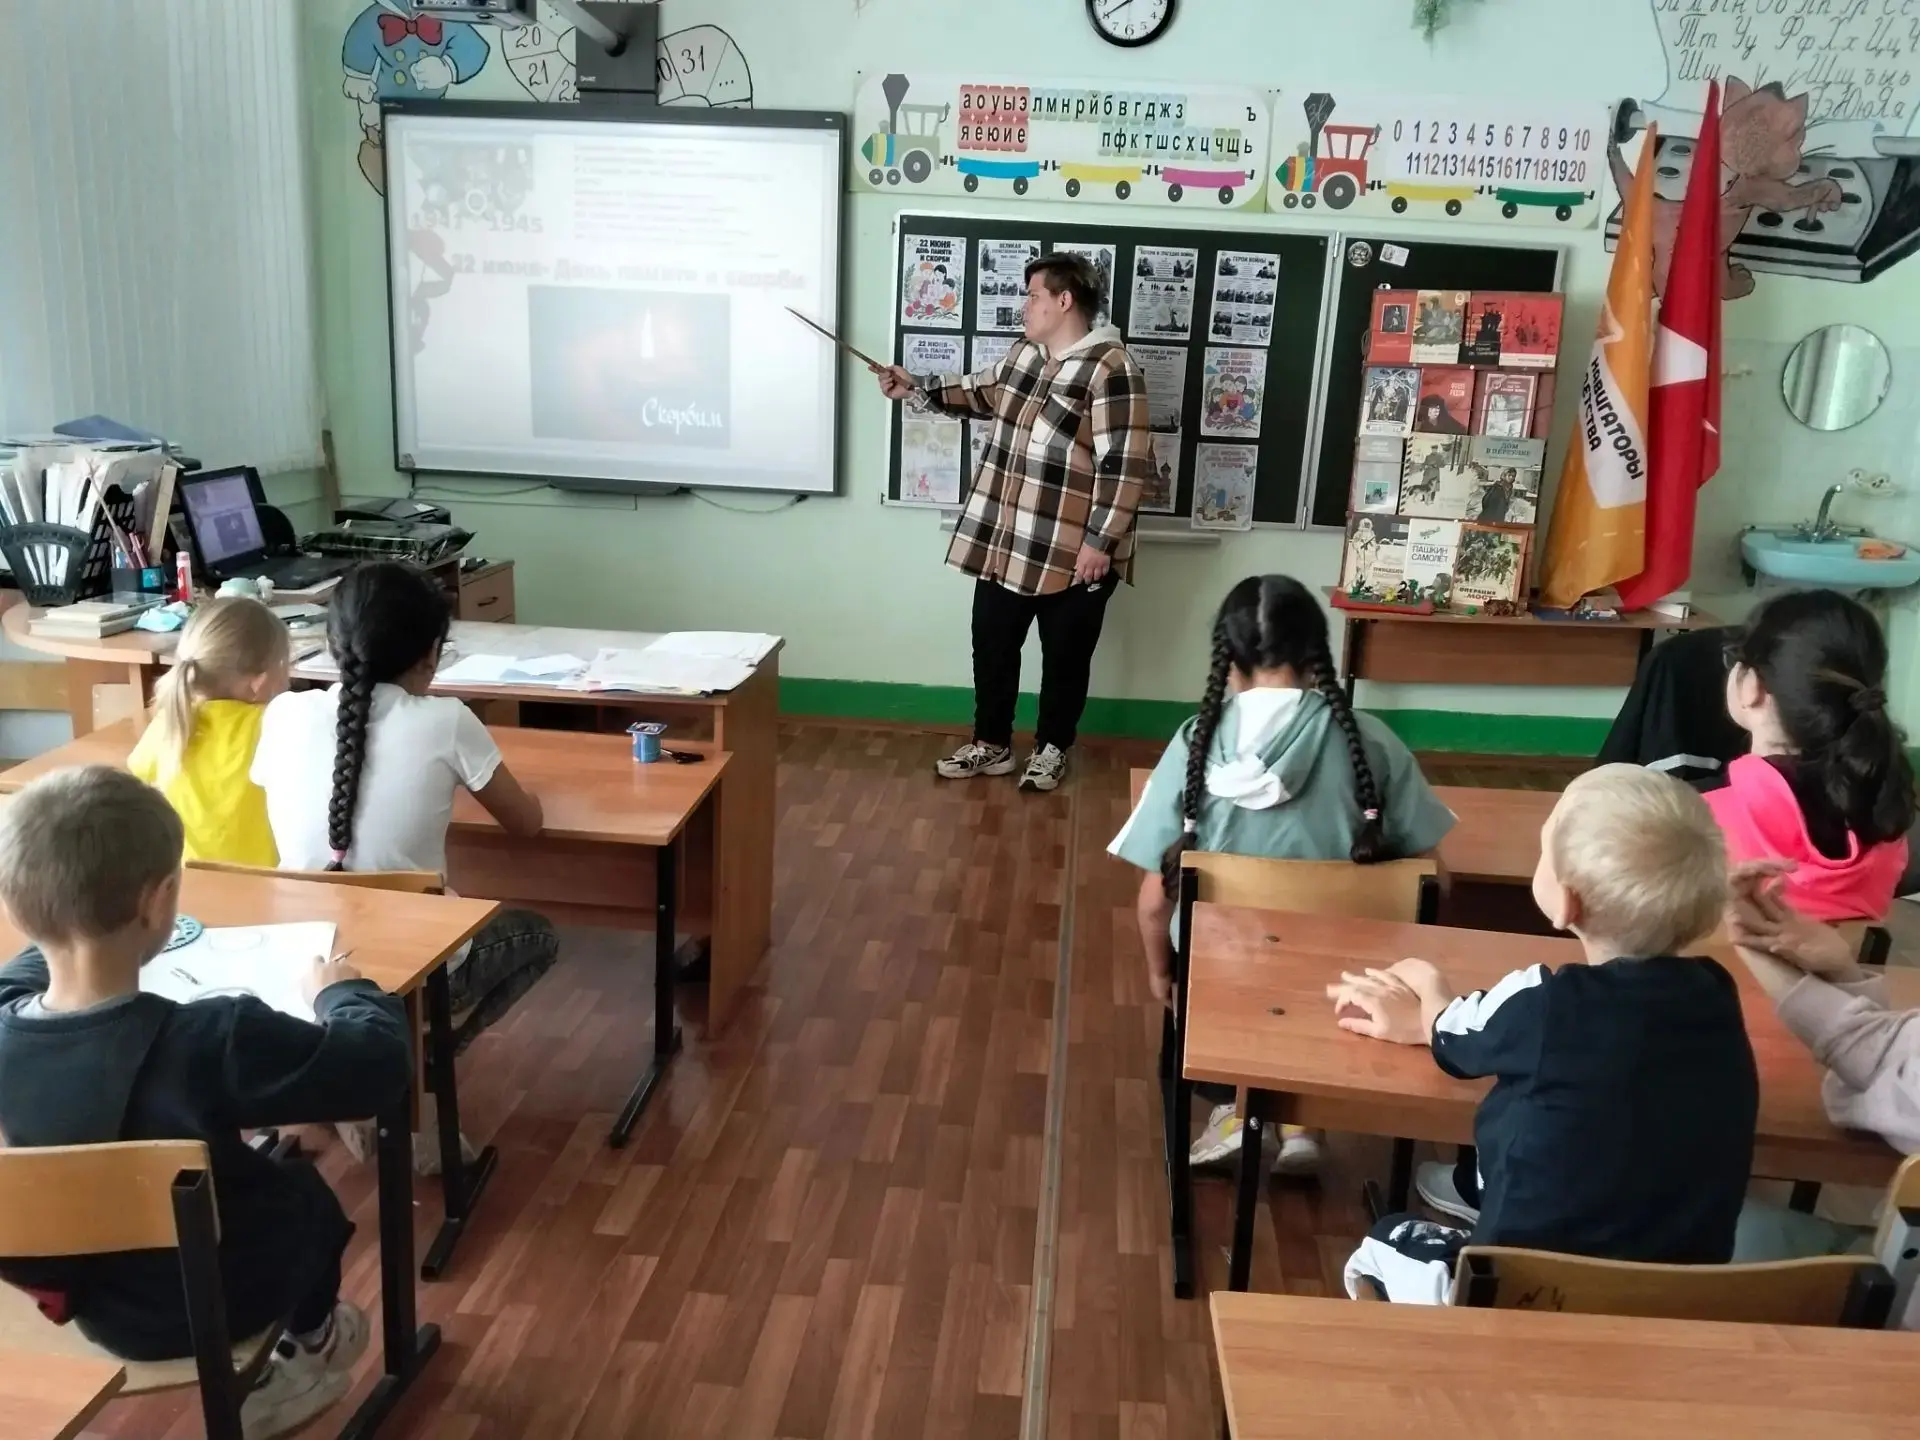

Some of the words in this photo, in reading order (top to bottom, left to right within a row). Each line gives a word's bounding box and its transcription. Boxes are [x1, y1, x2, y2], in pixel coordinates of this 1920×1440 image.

[515, 25, 542, 48] 20
[528, 59, 549, 87] 21
[681, 45, 705, 75] 31
[1393, 119, 1403, 142] 0
[1414, 120, 1422, 143] 1
[1429, 121, 1440, 144] 2
[1448, 122, 1458, 145] 3
[1466, 122, 1476, 145] 4
[1485, 124, 1495, 147] 5
[1504, 124, 1514, 147] 6
[1522, 125, 1532, 148] 7
[1540, 126, 1550, 149] 8
[1558, 127, 1567, 150] 9
[1574, 128, 1591, 151] 10
[1406, 151, 1421, 175] 11
[1423, 152, 1441, 175] 12
[1442, 153, 1459, 176] 13
[1460, 154, 1476, 177] 14
[1478, 155, 1495, 178] 15
[1497, 156, 1514, 179] 16
[1515, 157, 1532, 180] 17
[1533, 158, 1550, 181] 18
[1551, 159, 1568, 182] 19
[1567, 159, 1586, 183] 20
[919, 239, 929, 248] 22
[1412, 545, 1449, 554] ПАШКИН
